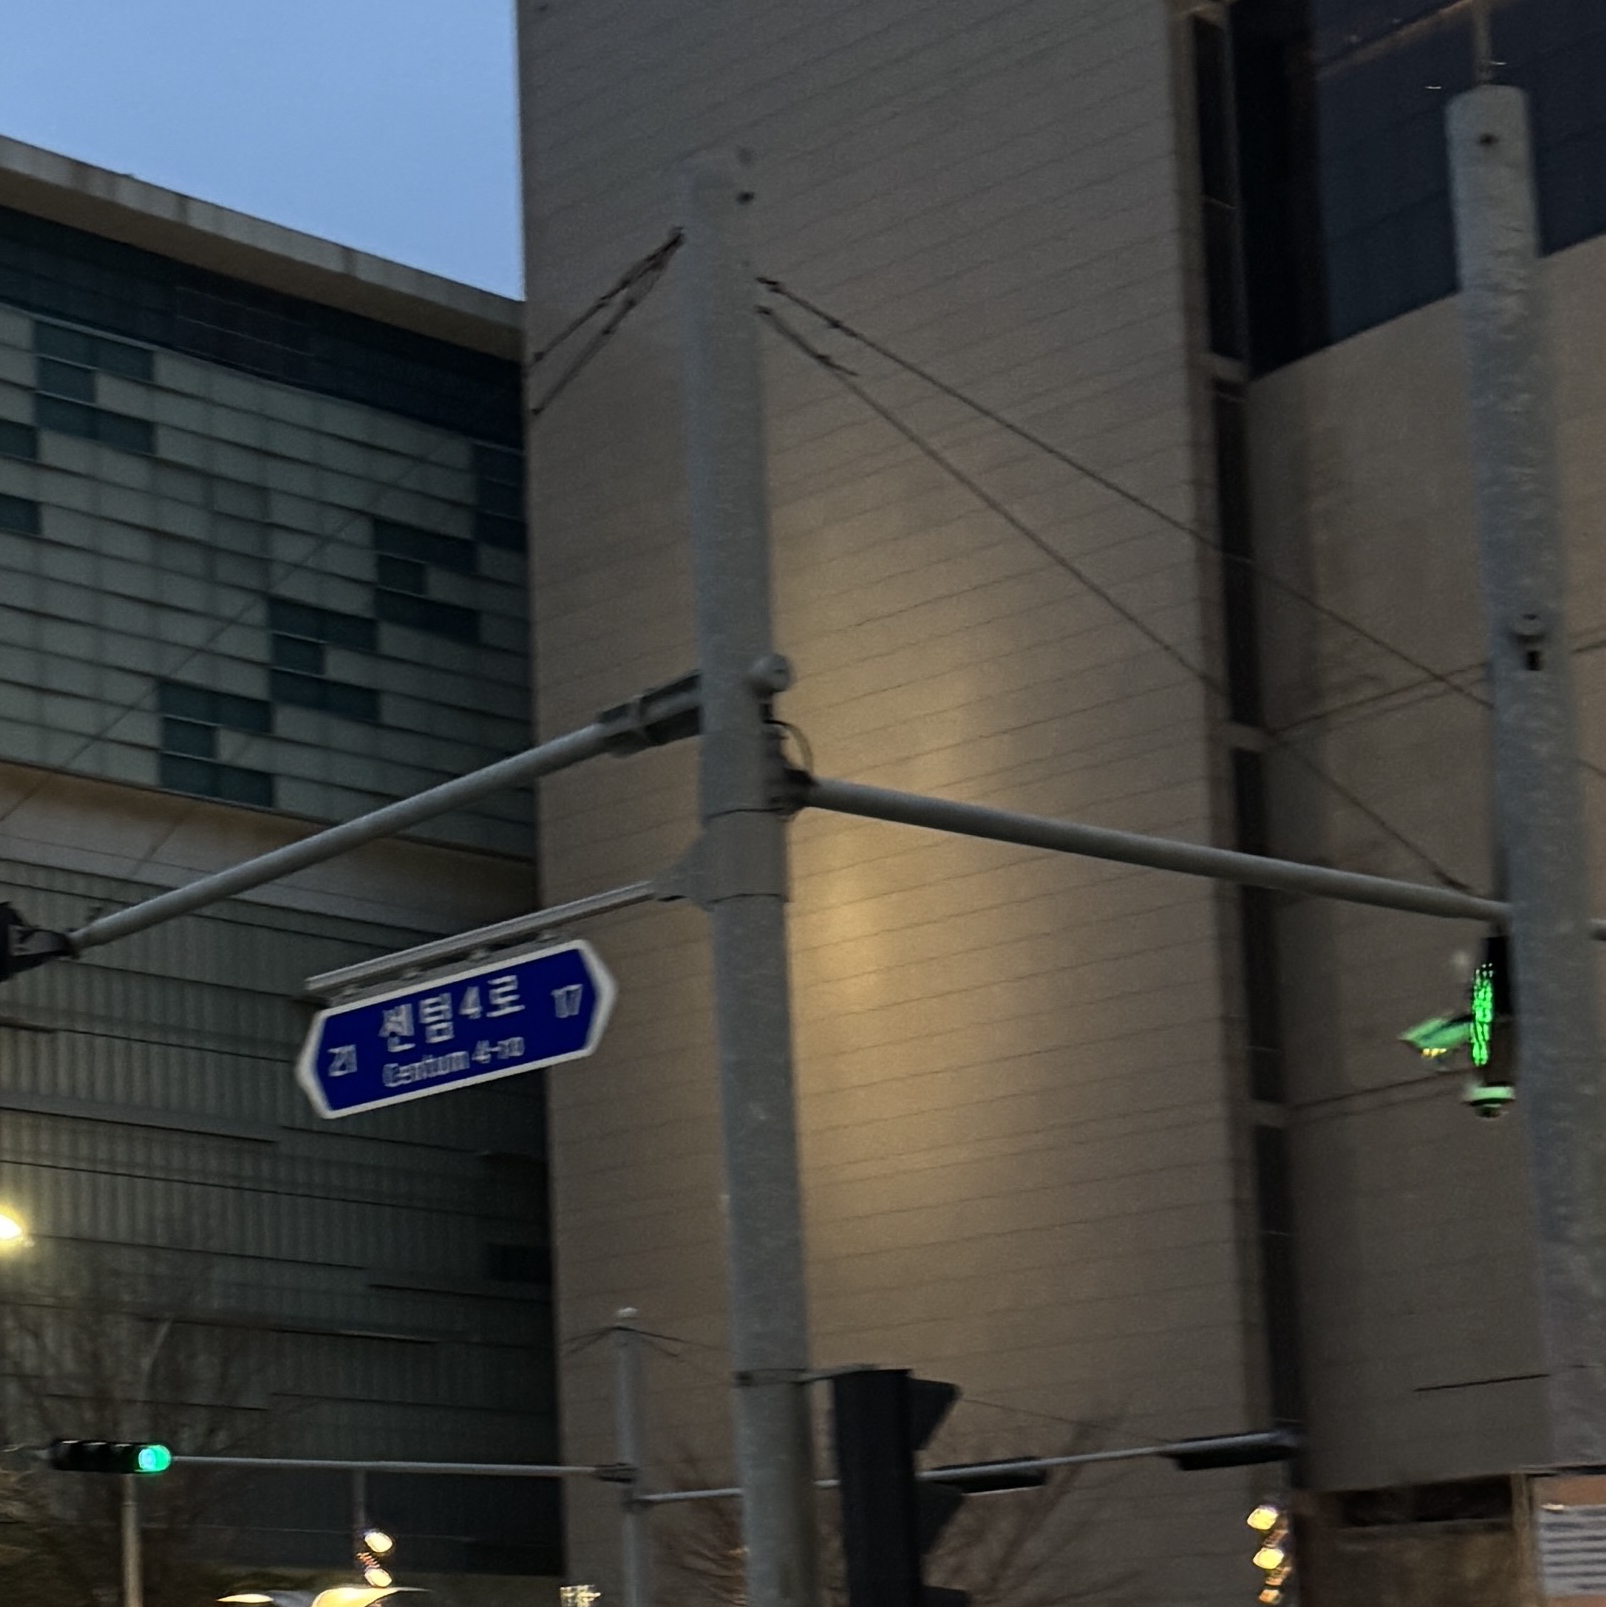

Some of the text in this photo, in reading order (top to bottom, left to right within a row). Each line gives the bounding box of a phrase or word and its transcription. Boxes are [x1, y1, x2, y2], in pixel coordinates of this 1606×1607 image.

[378, 975, 525, 1053] 센텀4로
[551, 984, 583, 1018] 17
[382, 1050, 470, 1088] Centum
